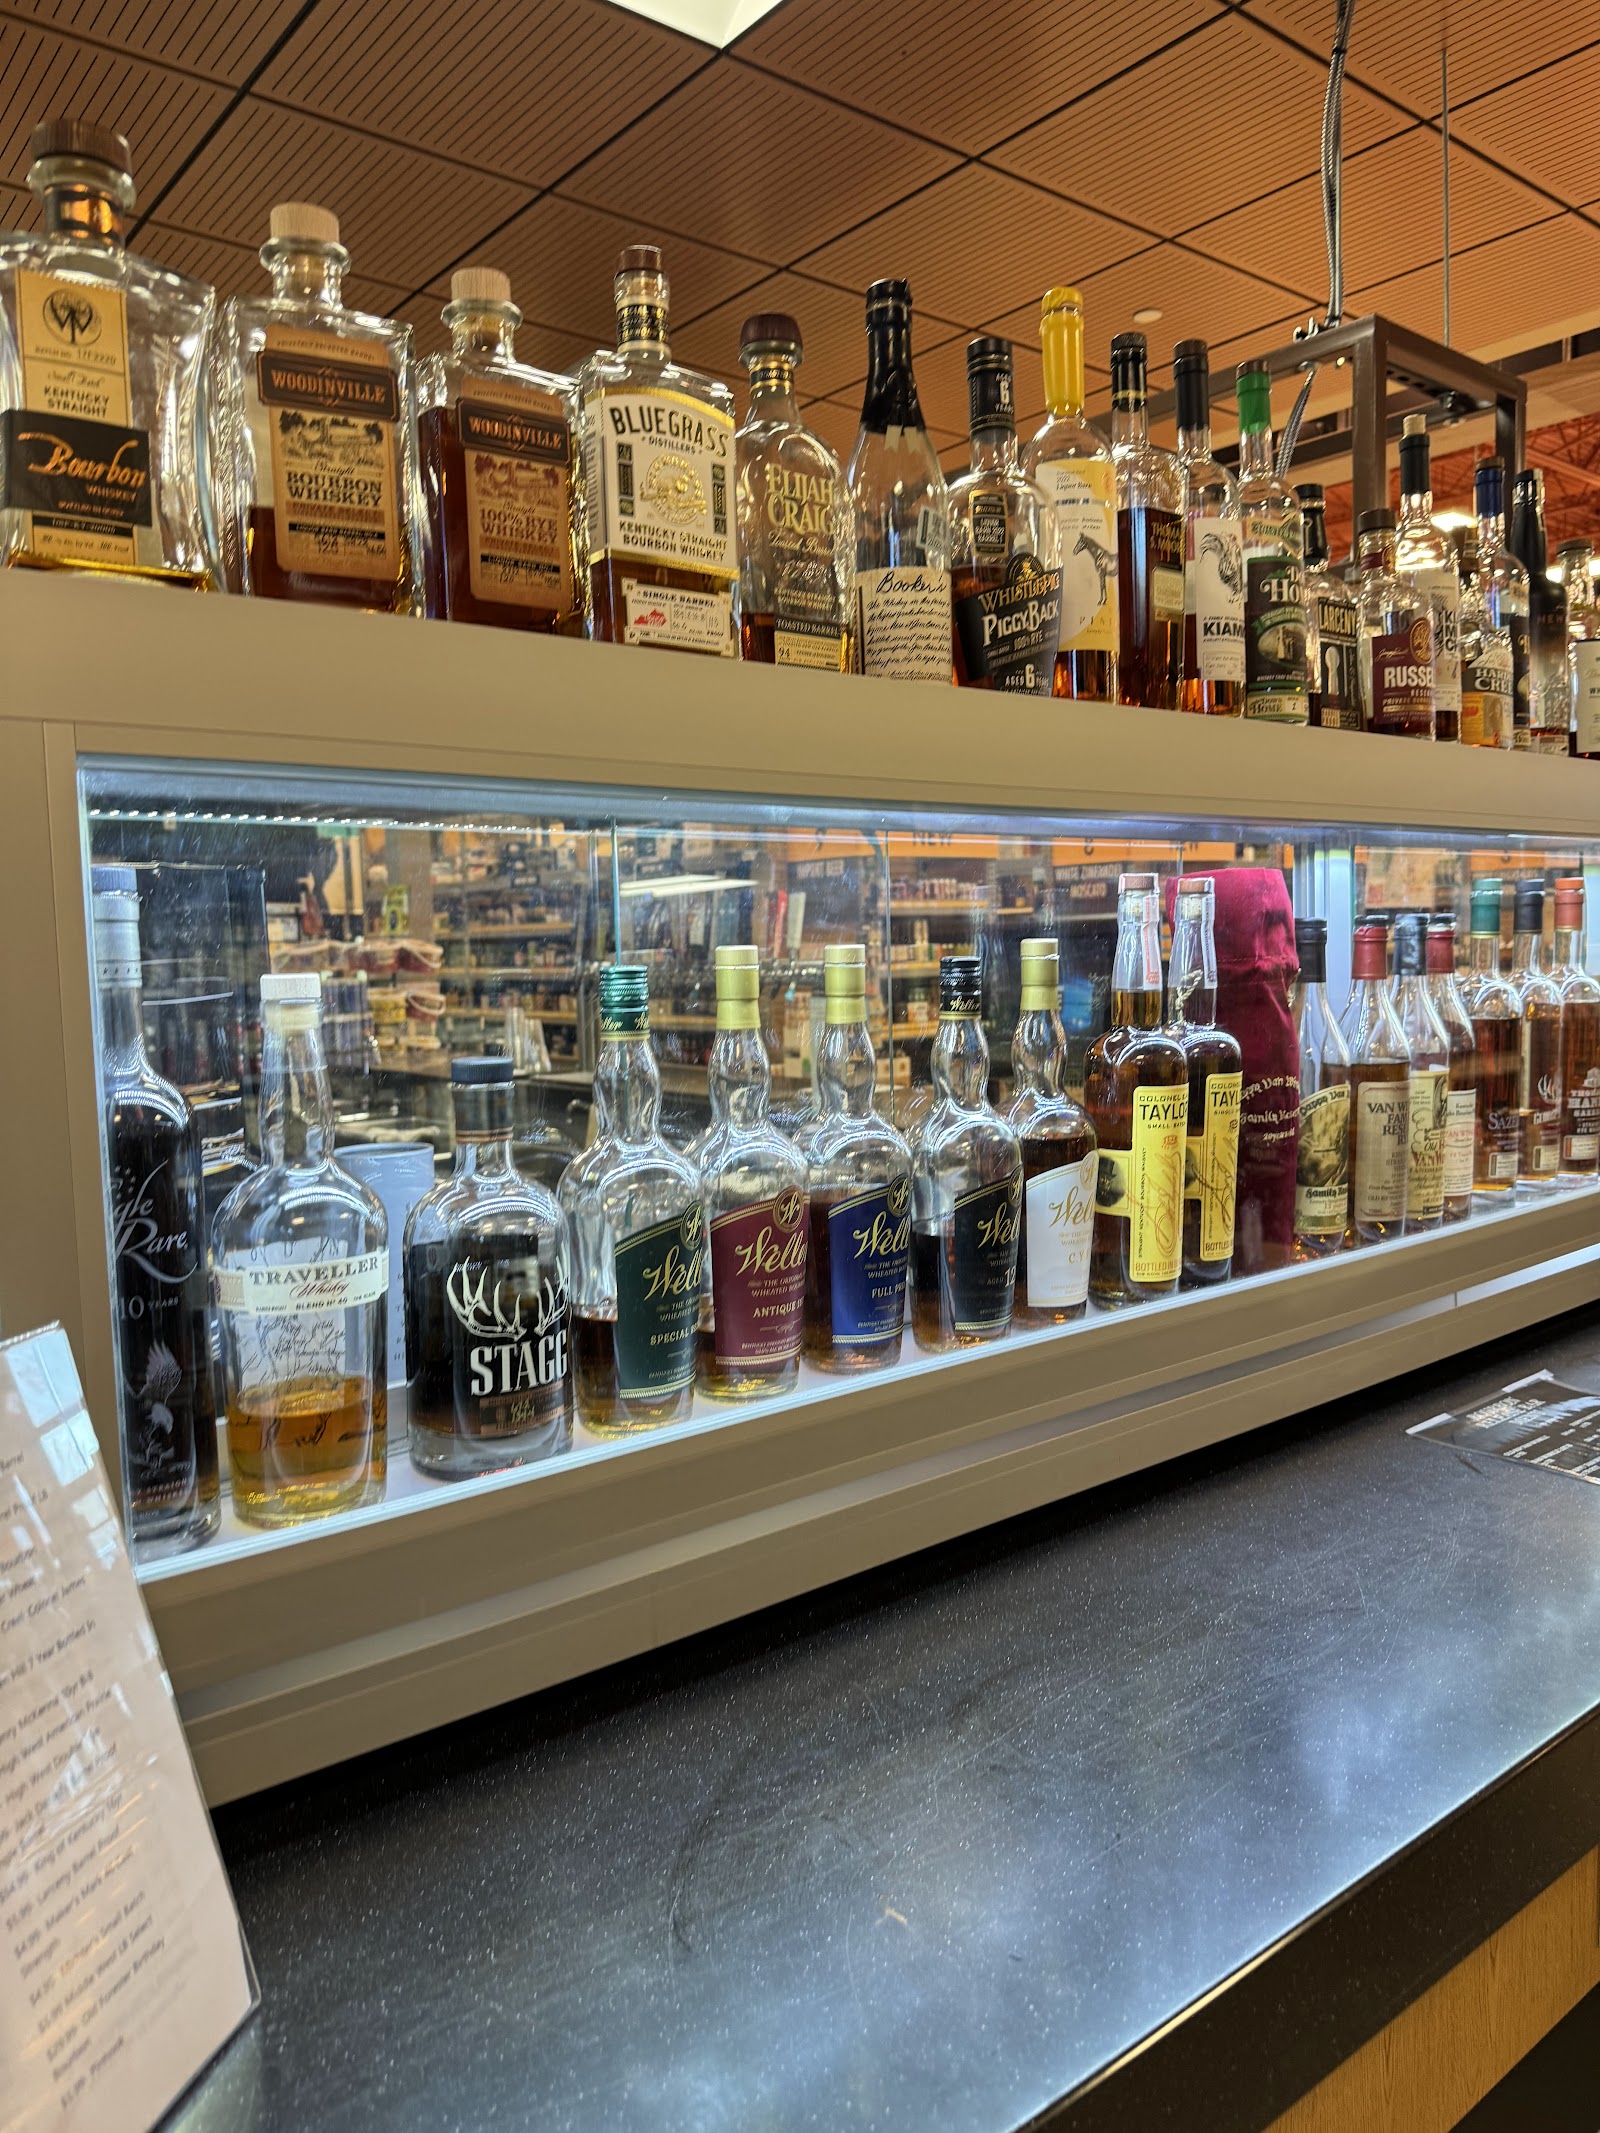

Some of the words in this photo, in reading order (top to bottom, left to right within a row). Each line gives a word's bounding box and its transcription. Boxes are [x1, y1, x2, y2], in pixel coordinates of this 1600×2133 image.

[44, 385, 110, 404] KENTUCKY
[271, 369, 386, 403] WOODINVILLE
[999, 380, 1010, 404] 6
[48, 398, 108, 418] STRAIGHT
[995, 403, 1014, 414] YEARS
[468, 415, 562, 449] WOODINVILLE
[609, 405, 729, 458] BLUEGRASS
[648, 436, 696, 455] DISTILLERS
[17, 431, 147, 488] Bourbon
[314, 460, 356, 476] Straight
[287, 471, 382, 493] BOURBON
[767, 462, 835, 505] ELIJAH
[86, 484, 137, 502] WHISKEY
[288, 485, 382, 507] WHISKEY
[481, 508, 523, 526] 100%
[525, 516, 559, 532] RYE
[767, 490, 835, 536] CRAIG
[482, 521, 557, 544] WHISKEY
[619, 521, 677, 540] KENTUCKY
[680, 530, 728, 550] STRAIGHT
[623, 534, 677, 553] BOURBON
[680, 543, 725, 562] WHISKEY
[876, 571, 948, 594] Booker's
[643, 590, 677, 602] SINGLE
[679, 595, 716, 608] BARREL
[978, 572, 1060, 614] WHISTLEPIG
[776, 618, 811, 633] TOASTED
[811, 623, 840, 637] BARREL
[1318, 603, 1357, 635] LARCENY
[1005, 675, 1025, 687] AGED
[1025, 664, 1035, 688] 6
[1139, 1094, 1181, 1103] COLONEL
[1329, 1089, 1345, 1100] Van
[1367, 1102, 1393, 1114] VAN
[1423, 1141, 1437, 1153] Old
[1411, 1150, 1433, 1167] VAN
[1305, 1187, 1337, 1198] Family
[1205, 1241, 1228, 1251] BOTTLED
[249, 1256, 379, 1287] TRAVELLER
[1135, 1261, 1168, 1272] BOTTLED
[289, 1281, 351, 1299] Whiskey
[751, 1286, 790, 1298] WHEATED
[871, 1285, 893, 1299] FULL
[120, 1295, 145, 1320] 10
[752, 1304, 796, 1319] ANTIQUE
[649, 1329, 690, 1346] SPECIAL
